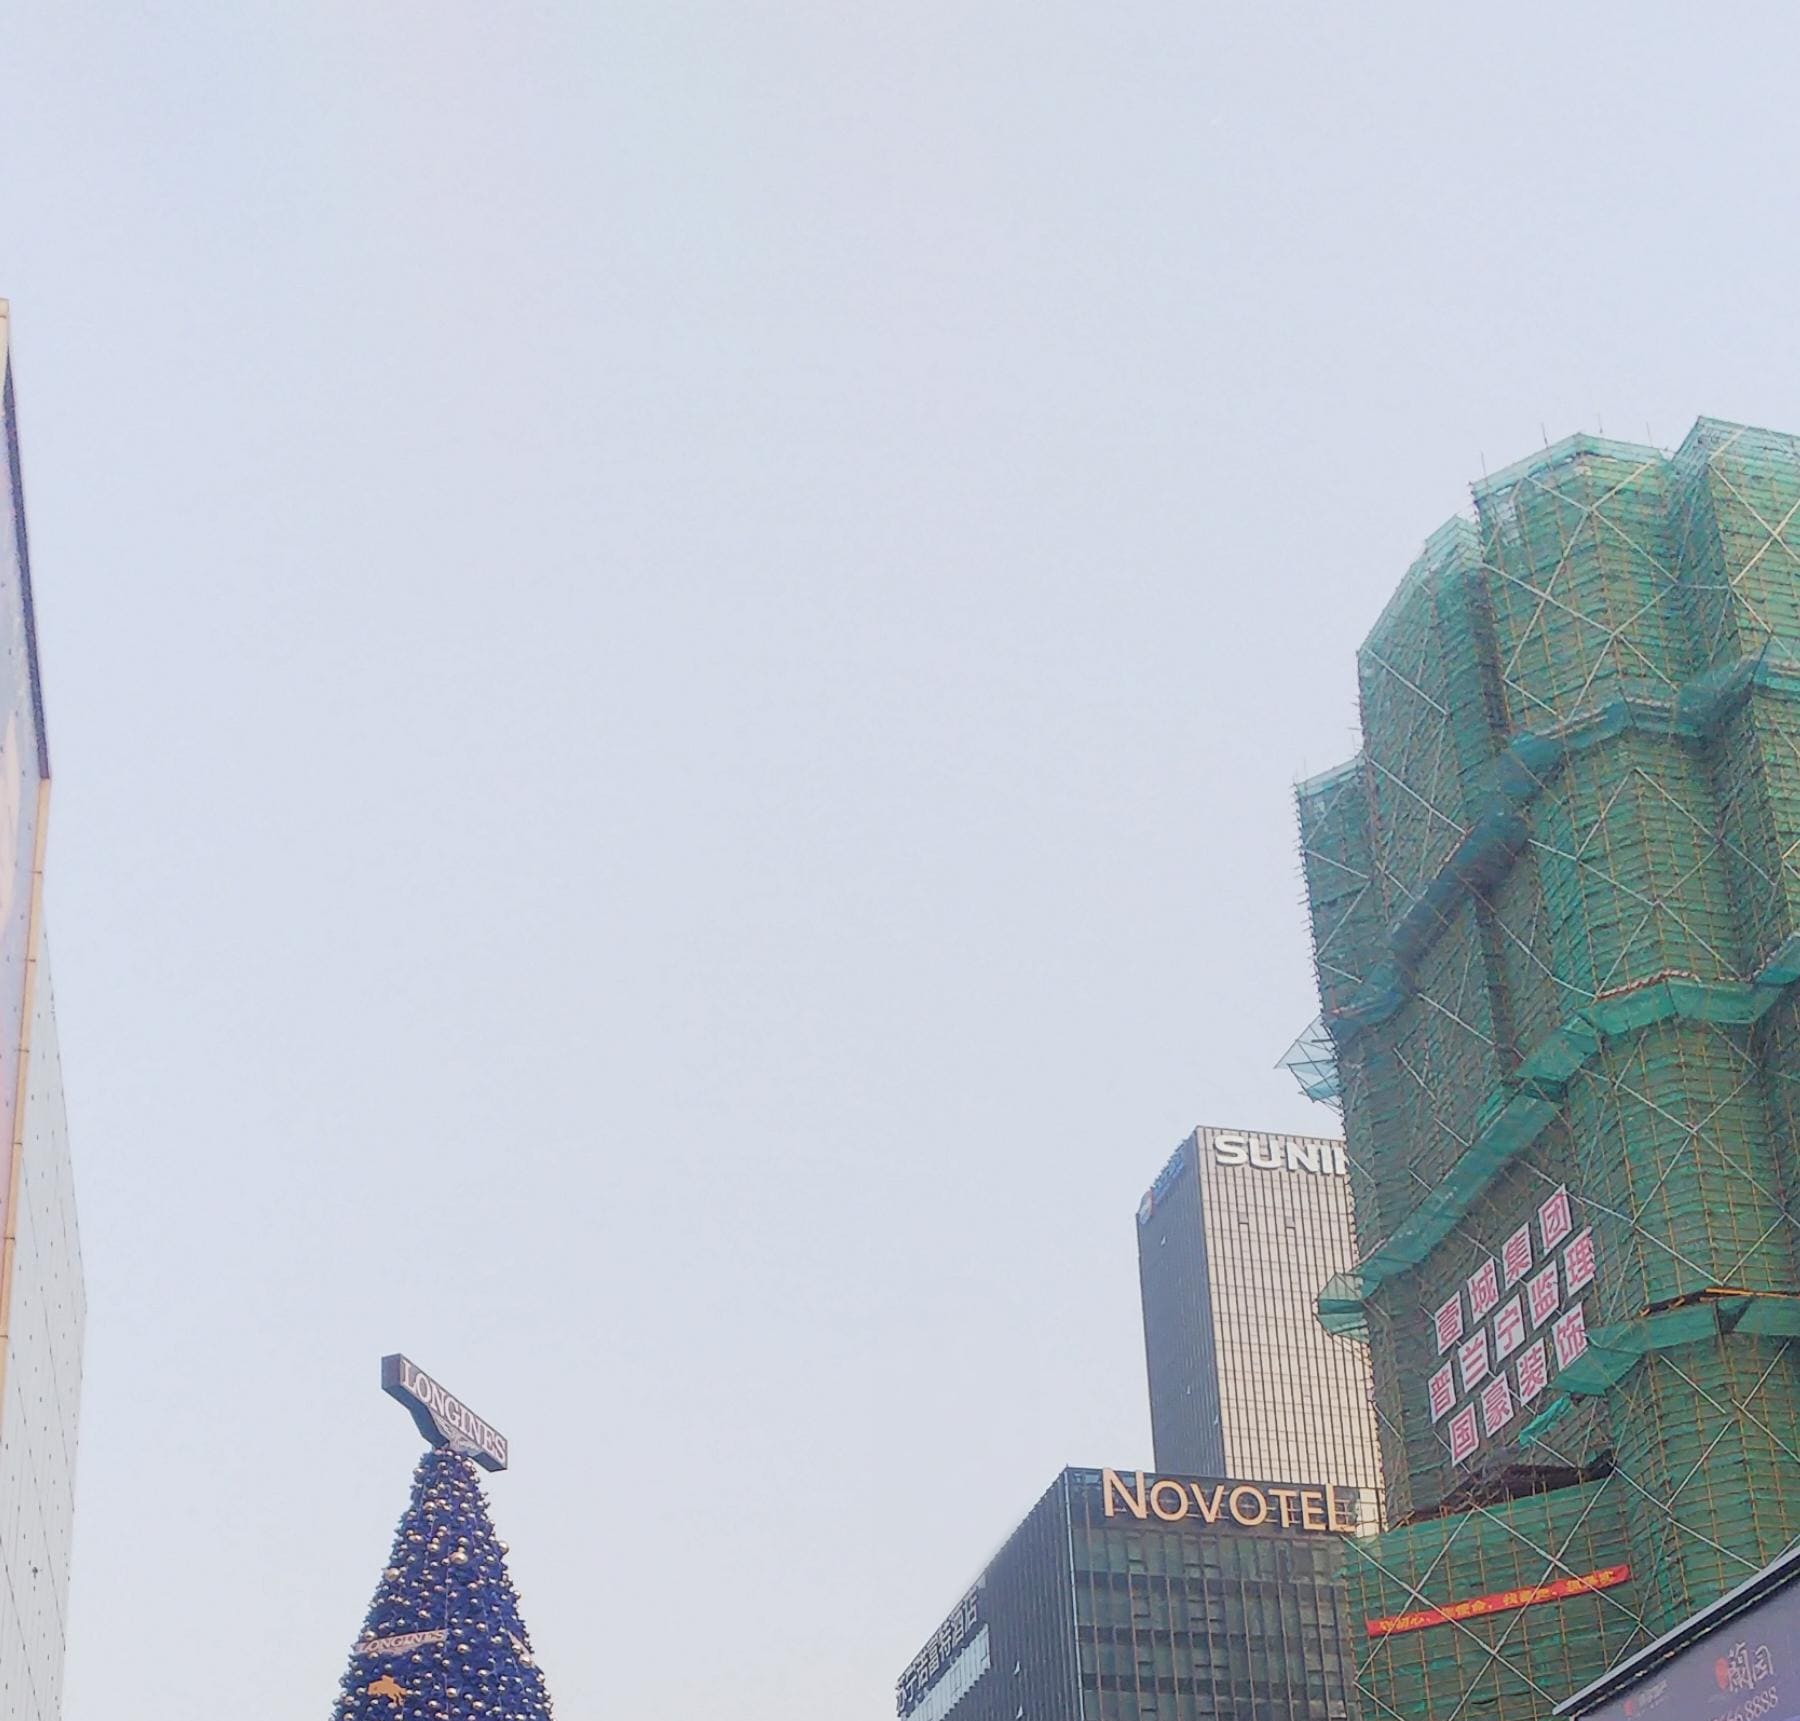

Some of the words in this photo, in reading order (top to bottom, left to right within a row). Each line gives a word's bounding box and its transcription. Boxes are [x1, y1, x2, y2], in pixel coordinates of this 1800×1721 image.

[402, 1360, 505, 1461] LONGINES
[1452, 1311, 1585, 1460] 国豪装饰
